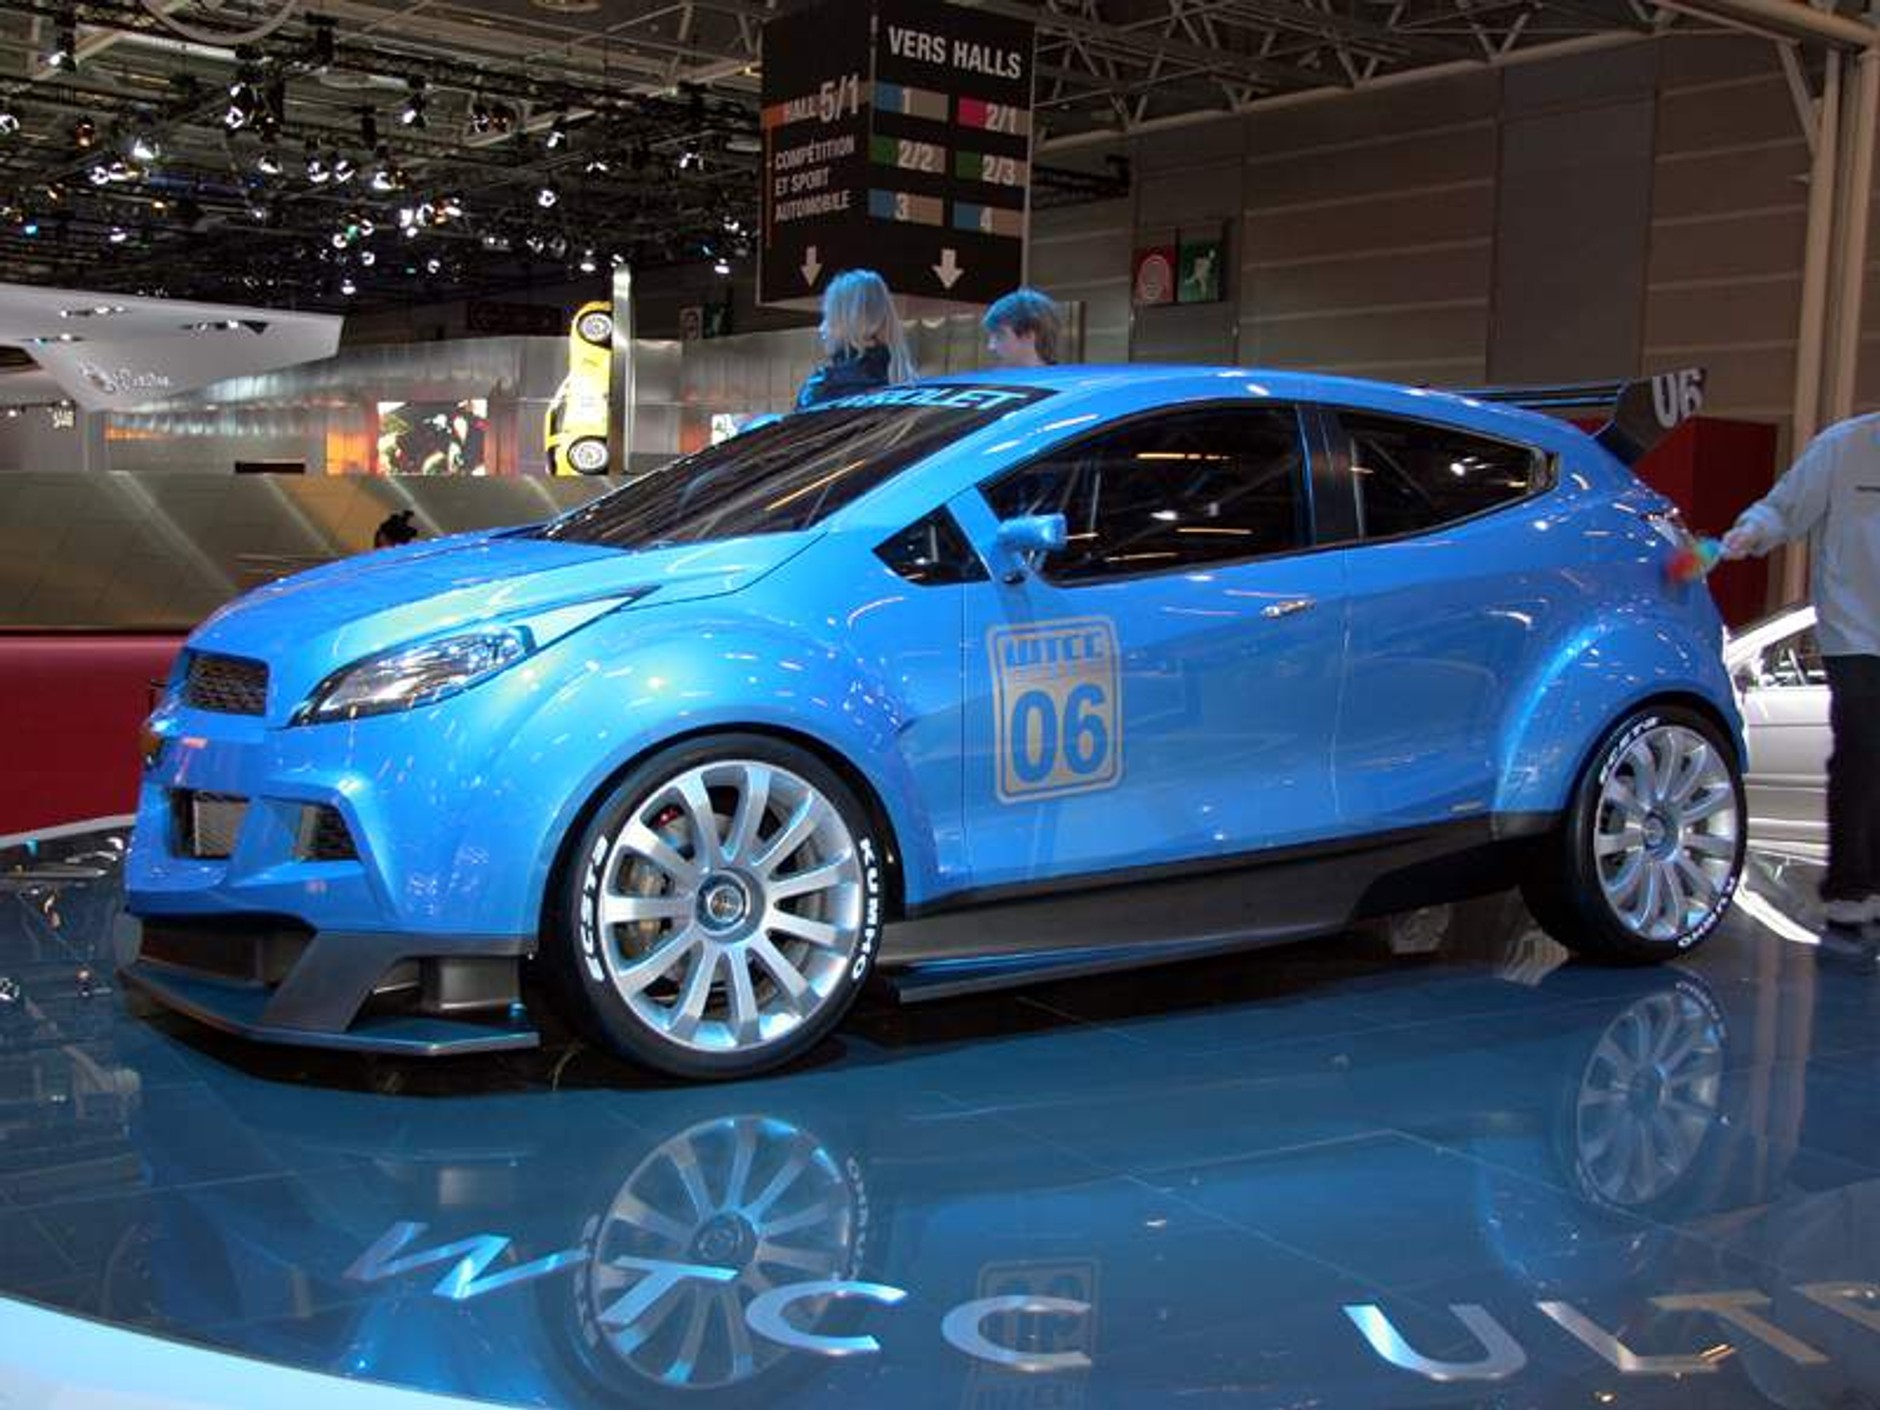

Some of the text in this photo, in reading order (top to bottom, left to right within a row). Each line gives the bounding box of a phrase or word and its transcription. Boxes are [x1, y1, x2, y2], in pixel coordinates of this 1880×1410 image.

[888, 25, 1021, 79] VERS HALLS
[820, 73, 859, 123] 5/1
[902, 87, 912, 115] 1
[985, 103, 1017, 133] 2/1
[775, 135, 855, 171] COMPÉTITION
[898, 140, 934, 173] 2/2
[982, 154, 1016, 185] 2/3
[775, 166, 830, 197] ET SPORT
[775, 190, 851, 223] AUTOMOBILE
[895, 192, 911, 220] 3
[980, 206, 993, 233] 4
[1651, 368, 1703, 429] 06
[1011, 682, 1109, 783] 06
[853, 838, 878, 980] KUMHO
